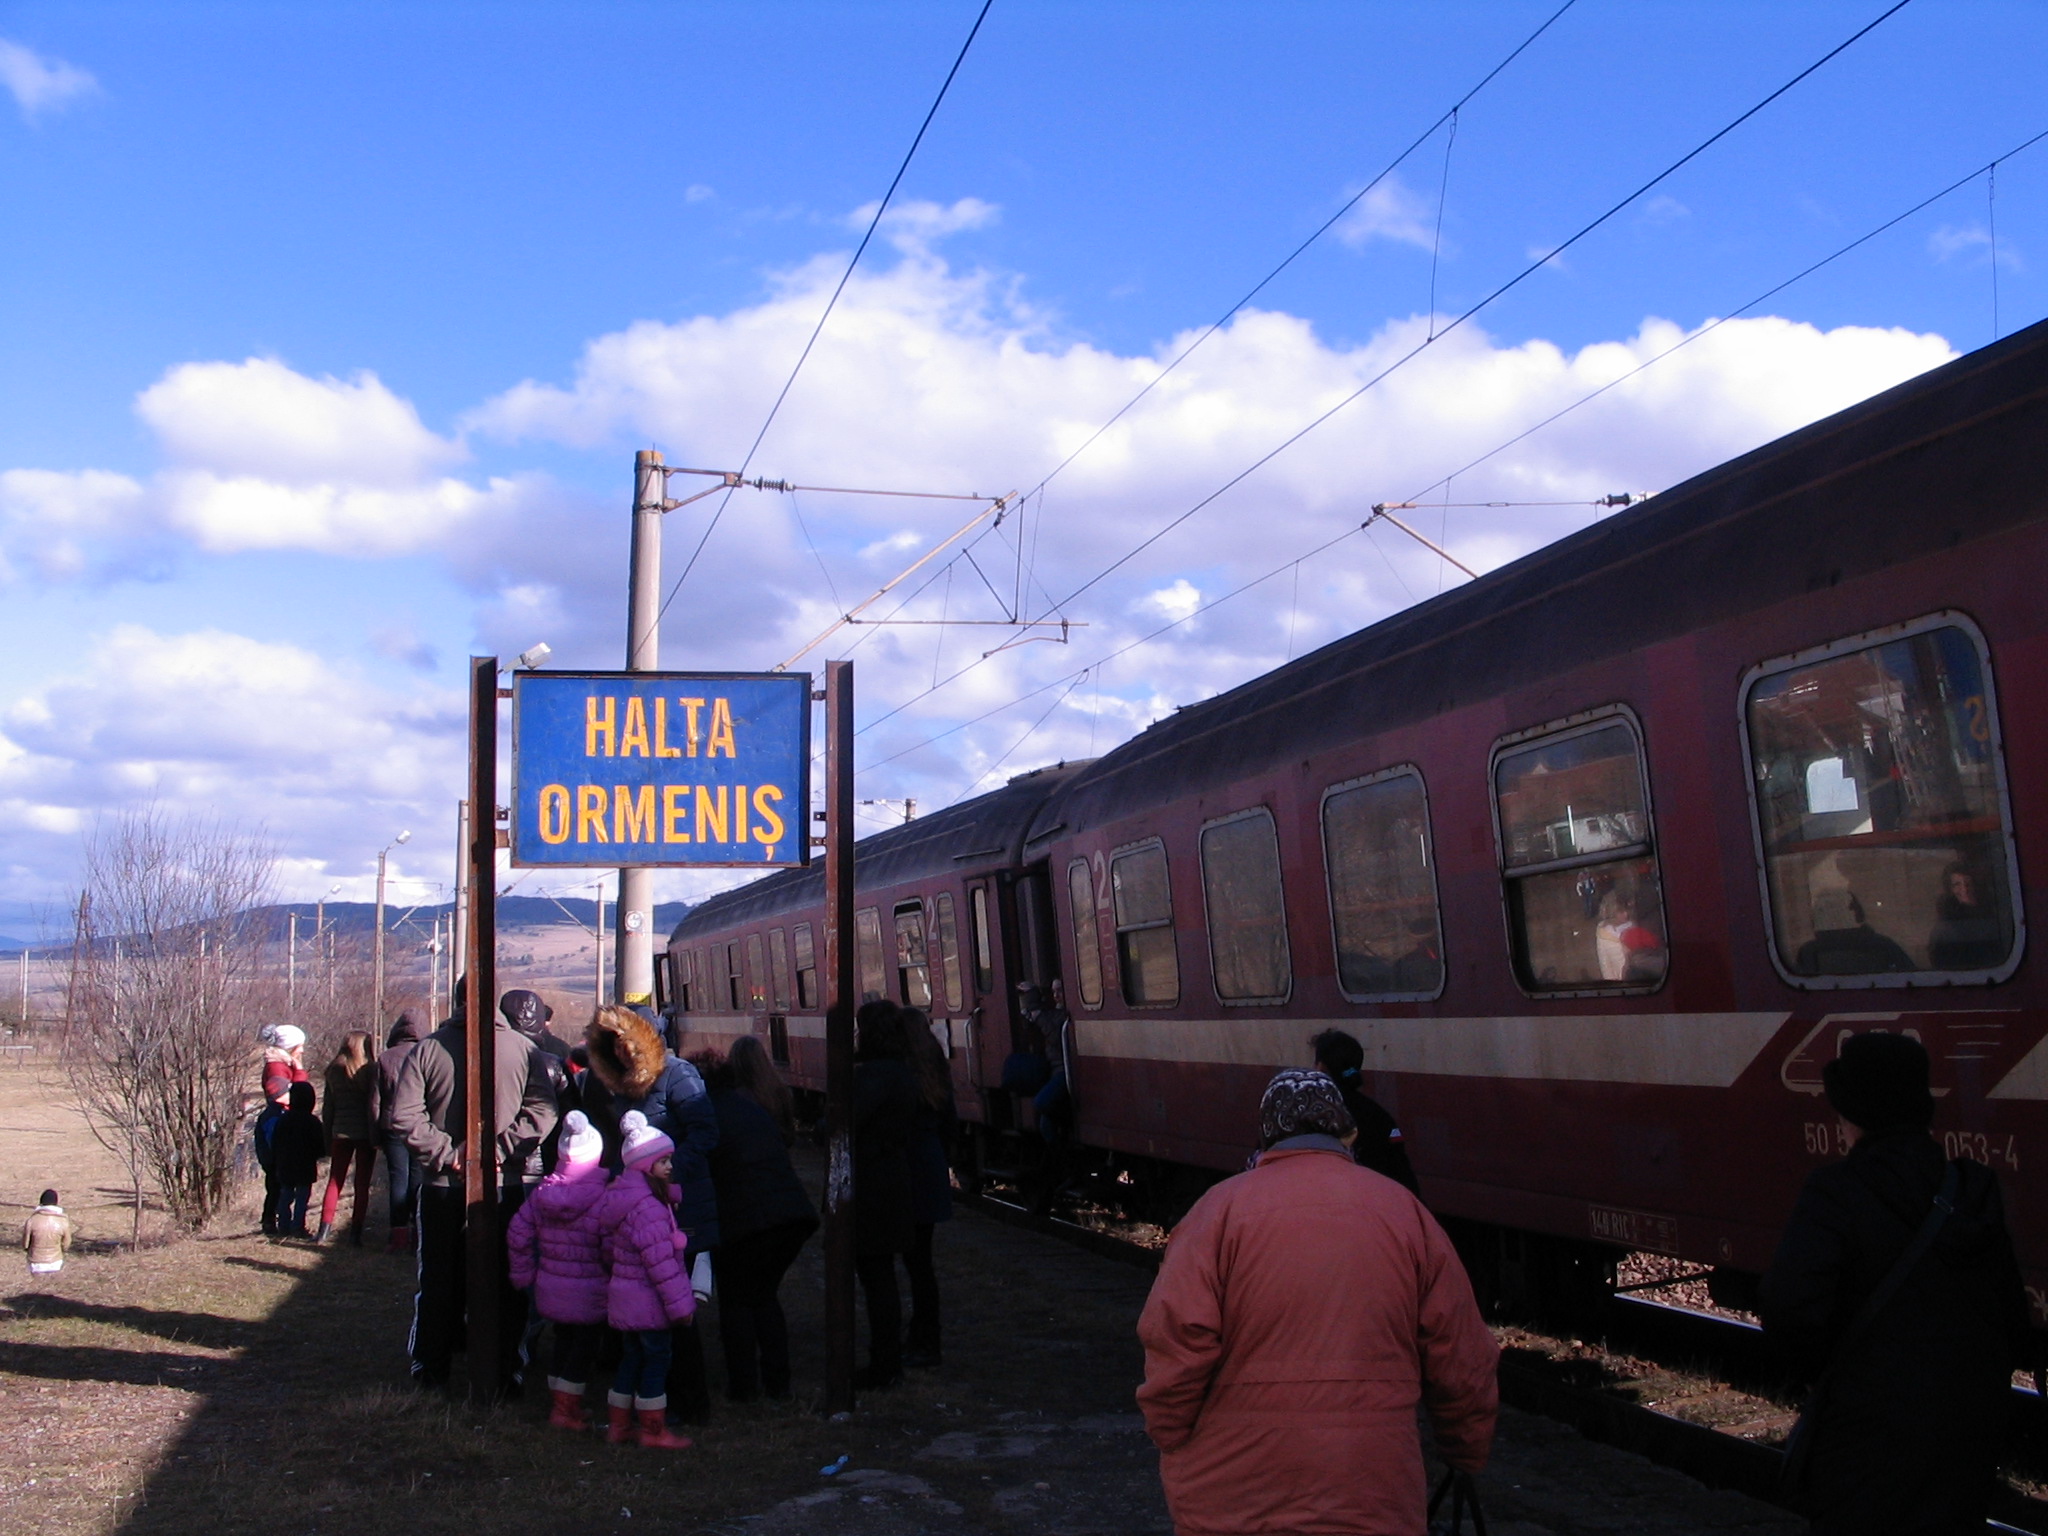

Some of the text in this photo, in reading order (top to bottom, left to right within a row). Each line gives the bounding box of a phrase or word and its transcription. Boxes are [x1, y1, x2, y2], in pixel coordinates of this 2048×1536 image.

[585, 696, 737, 758] HALTA
[538, 784, 785, 861] ORMENIȘ
[1094, 850, 1110, 909] 2
[926, 896, 938, 940] 2
[1804, 1122, 1829, 1155] 50
